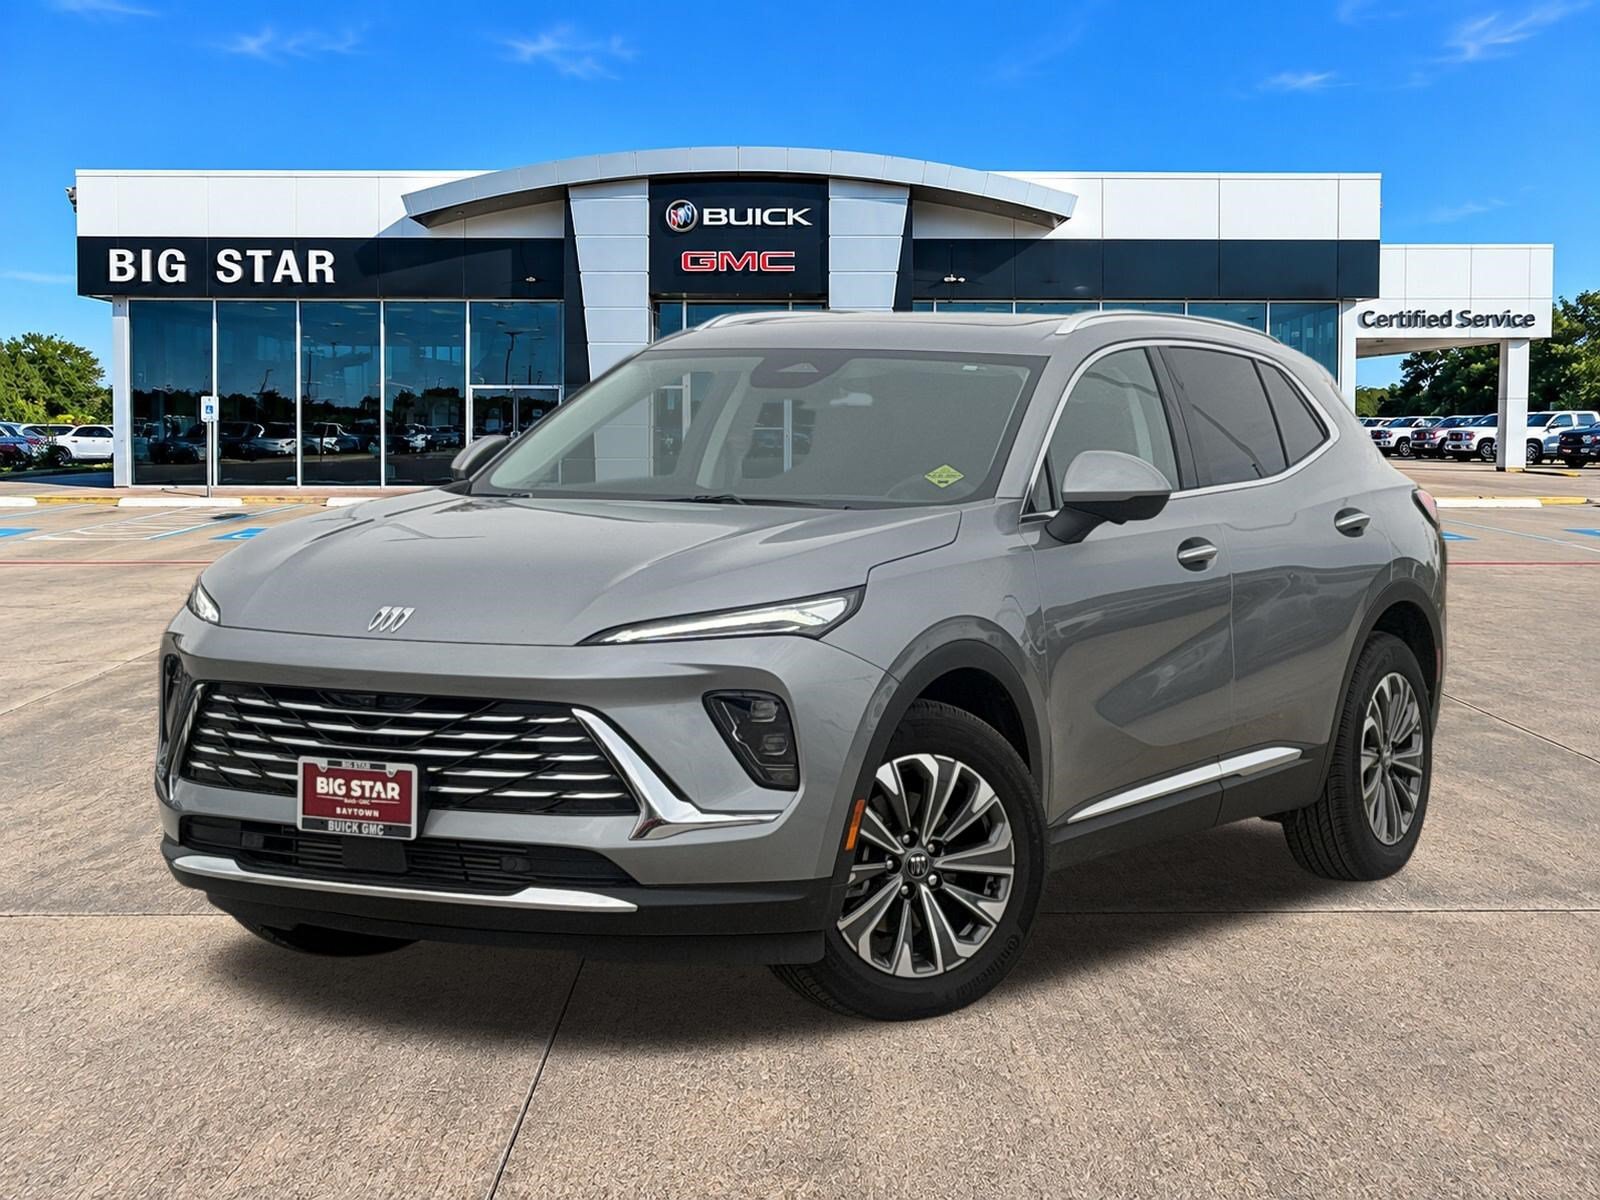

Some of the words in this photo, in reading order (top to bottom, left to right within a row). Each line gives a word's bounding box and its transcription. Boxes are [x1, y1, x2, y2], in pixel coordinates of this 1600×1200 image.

[703, 208, 813, 226] BUICK
[108, 248, 187, 283] BIG
[216, 248, 336, 284] STAR
[681, 250, 796, 272] GMC
[1359, 309, 1453, 328] Certified
[1456, 309, 1536, 328] Service
[316, 776, 347, 796] BIG
[350, 779, 400, 801] STAR
[335, 806, 380, 817] BAYTOWN
[328, 820, 360, 834] BUICK
[361, 823, 385, 836] GMC
